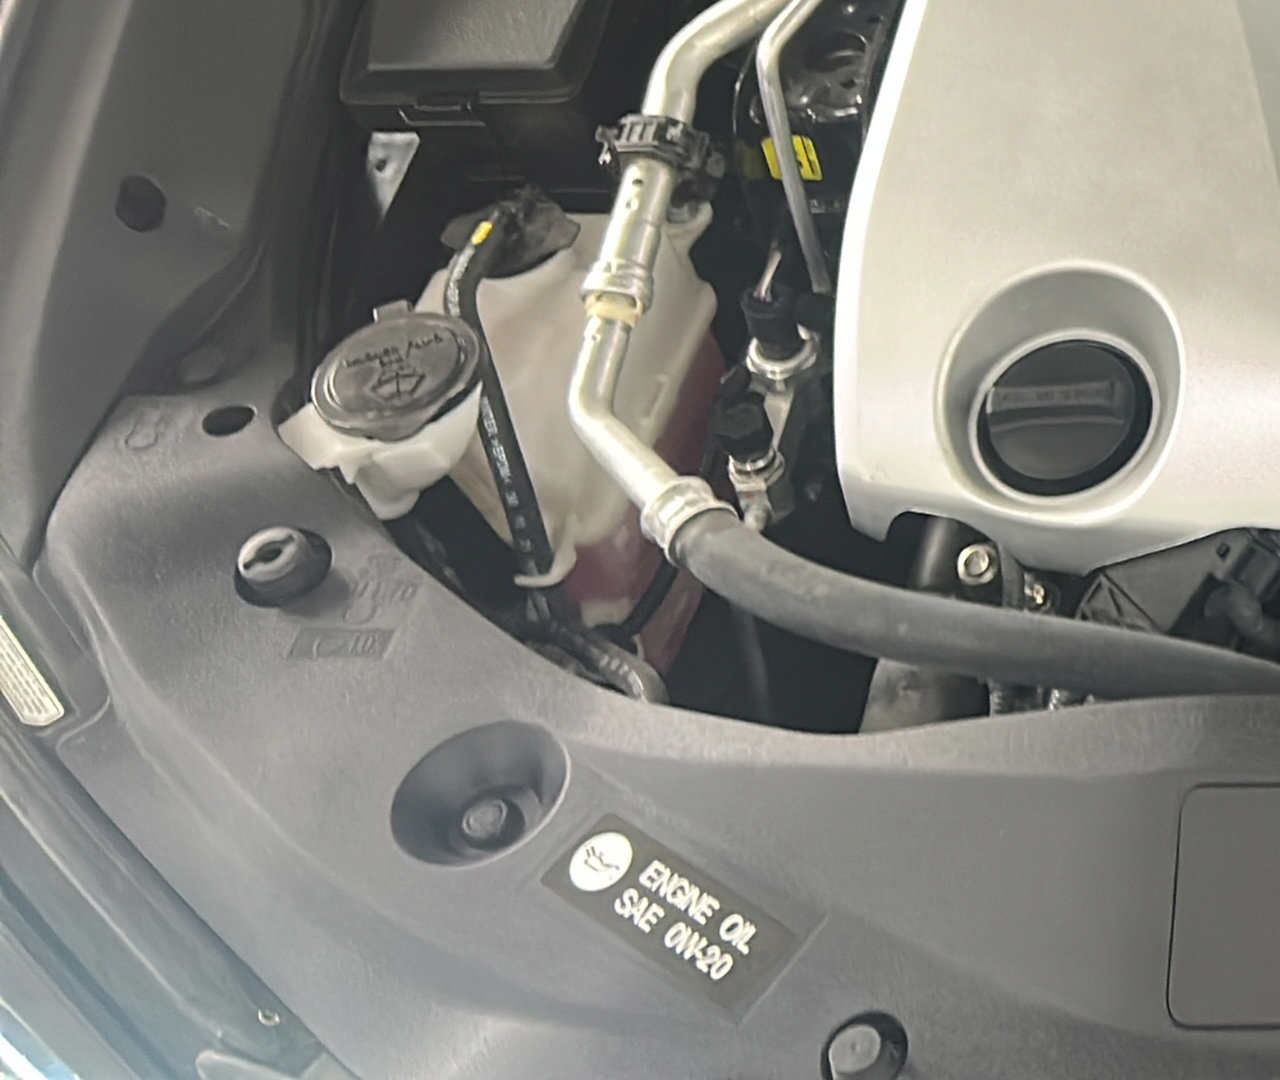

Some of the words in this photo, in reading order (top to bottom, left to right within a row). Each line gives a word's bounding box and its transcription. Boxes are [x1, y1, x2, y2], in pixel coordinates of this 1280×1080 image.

[614, 887, 665, 933] SAE
[664, 921, 734, 980] 0W-20
[638, 859, 720, 925] ENGINE
[719, 913, 757, 955] OIL
